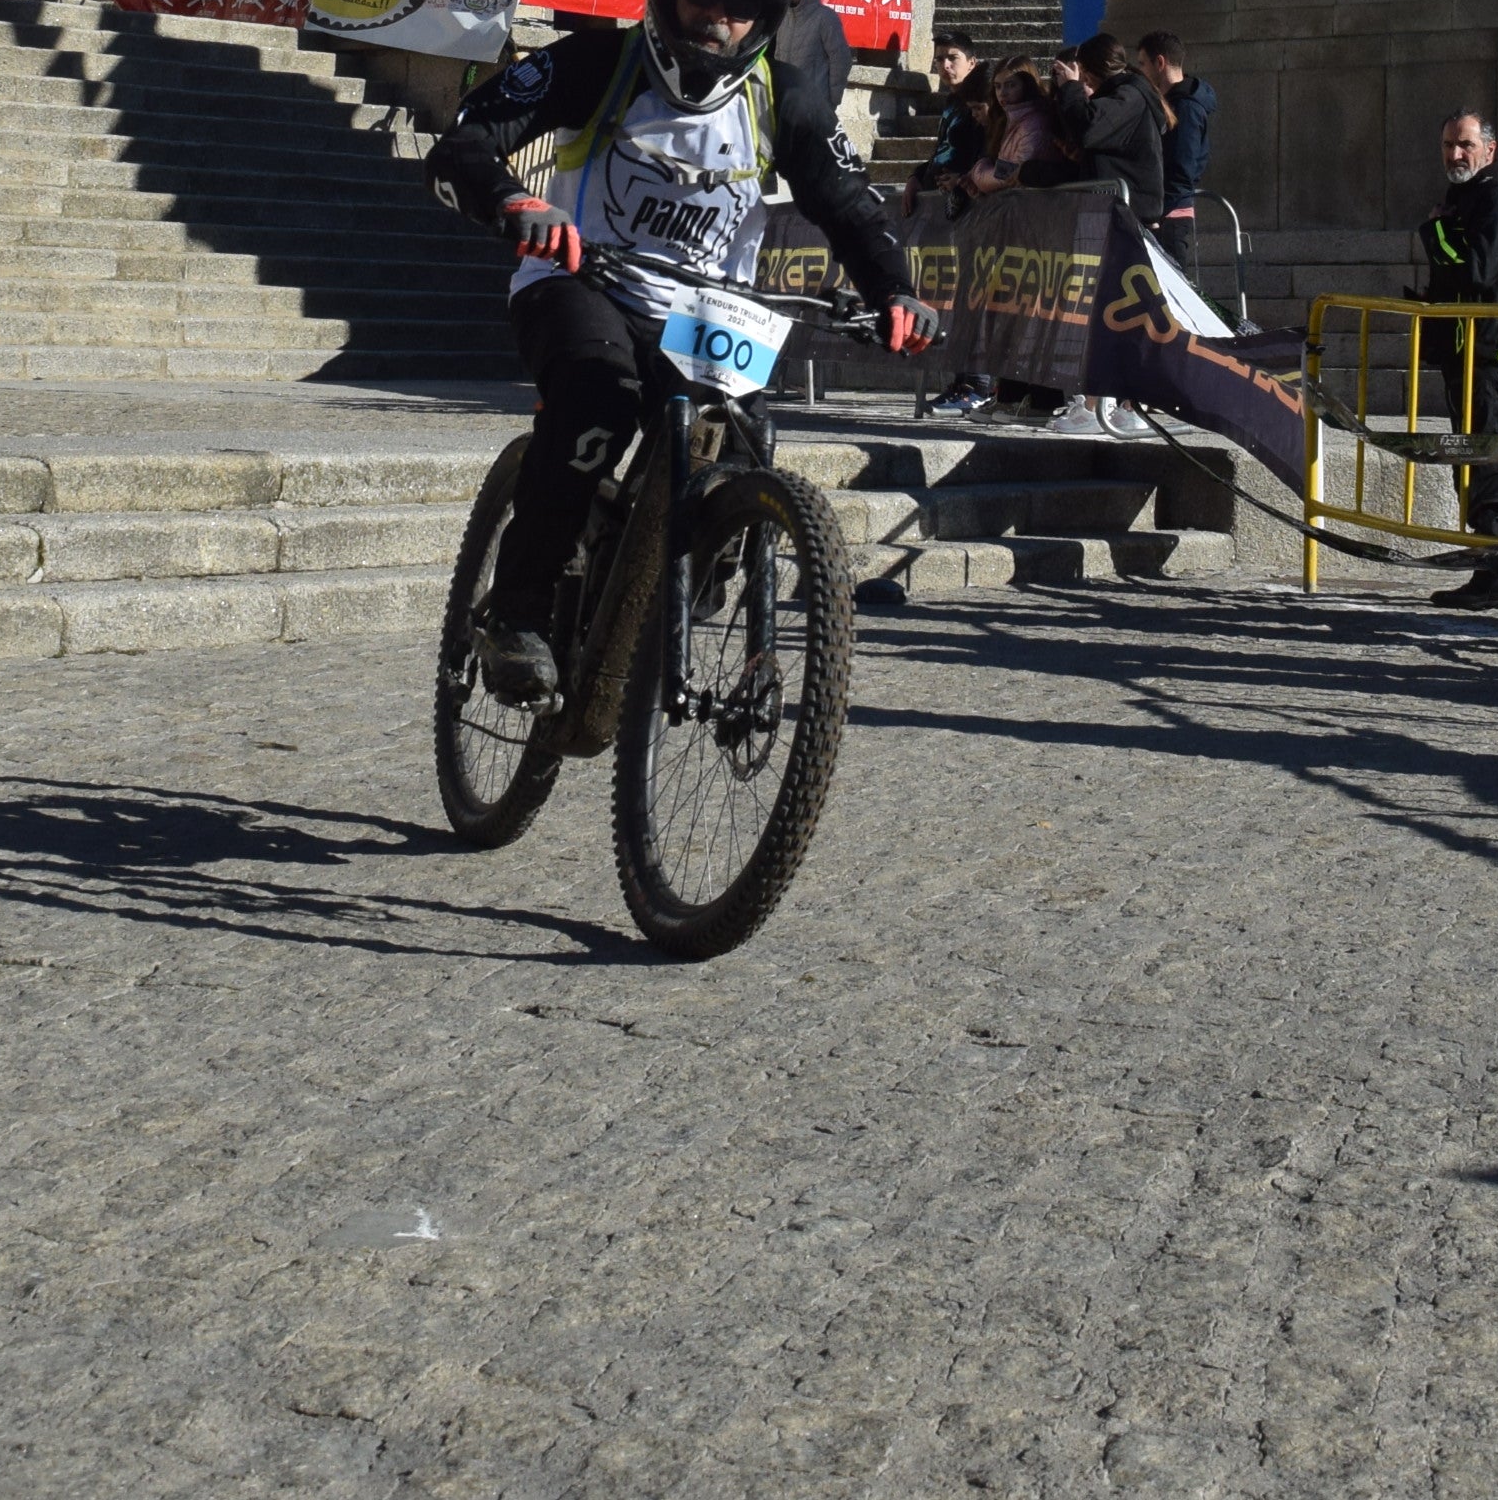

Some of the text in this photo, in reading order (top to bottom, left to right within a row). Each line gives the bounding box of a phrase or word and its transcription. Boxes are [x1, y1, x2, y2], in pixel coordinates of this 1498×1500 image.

[706, 295, 739, 312] ENDURO
[740, 307, 767, 326] TRUJILLO
[692, 324, 753, 371] 100
